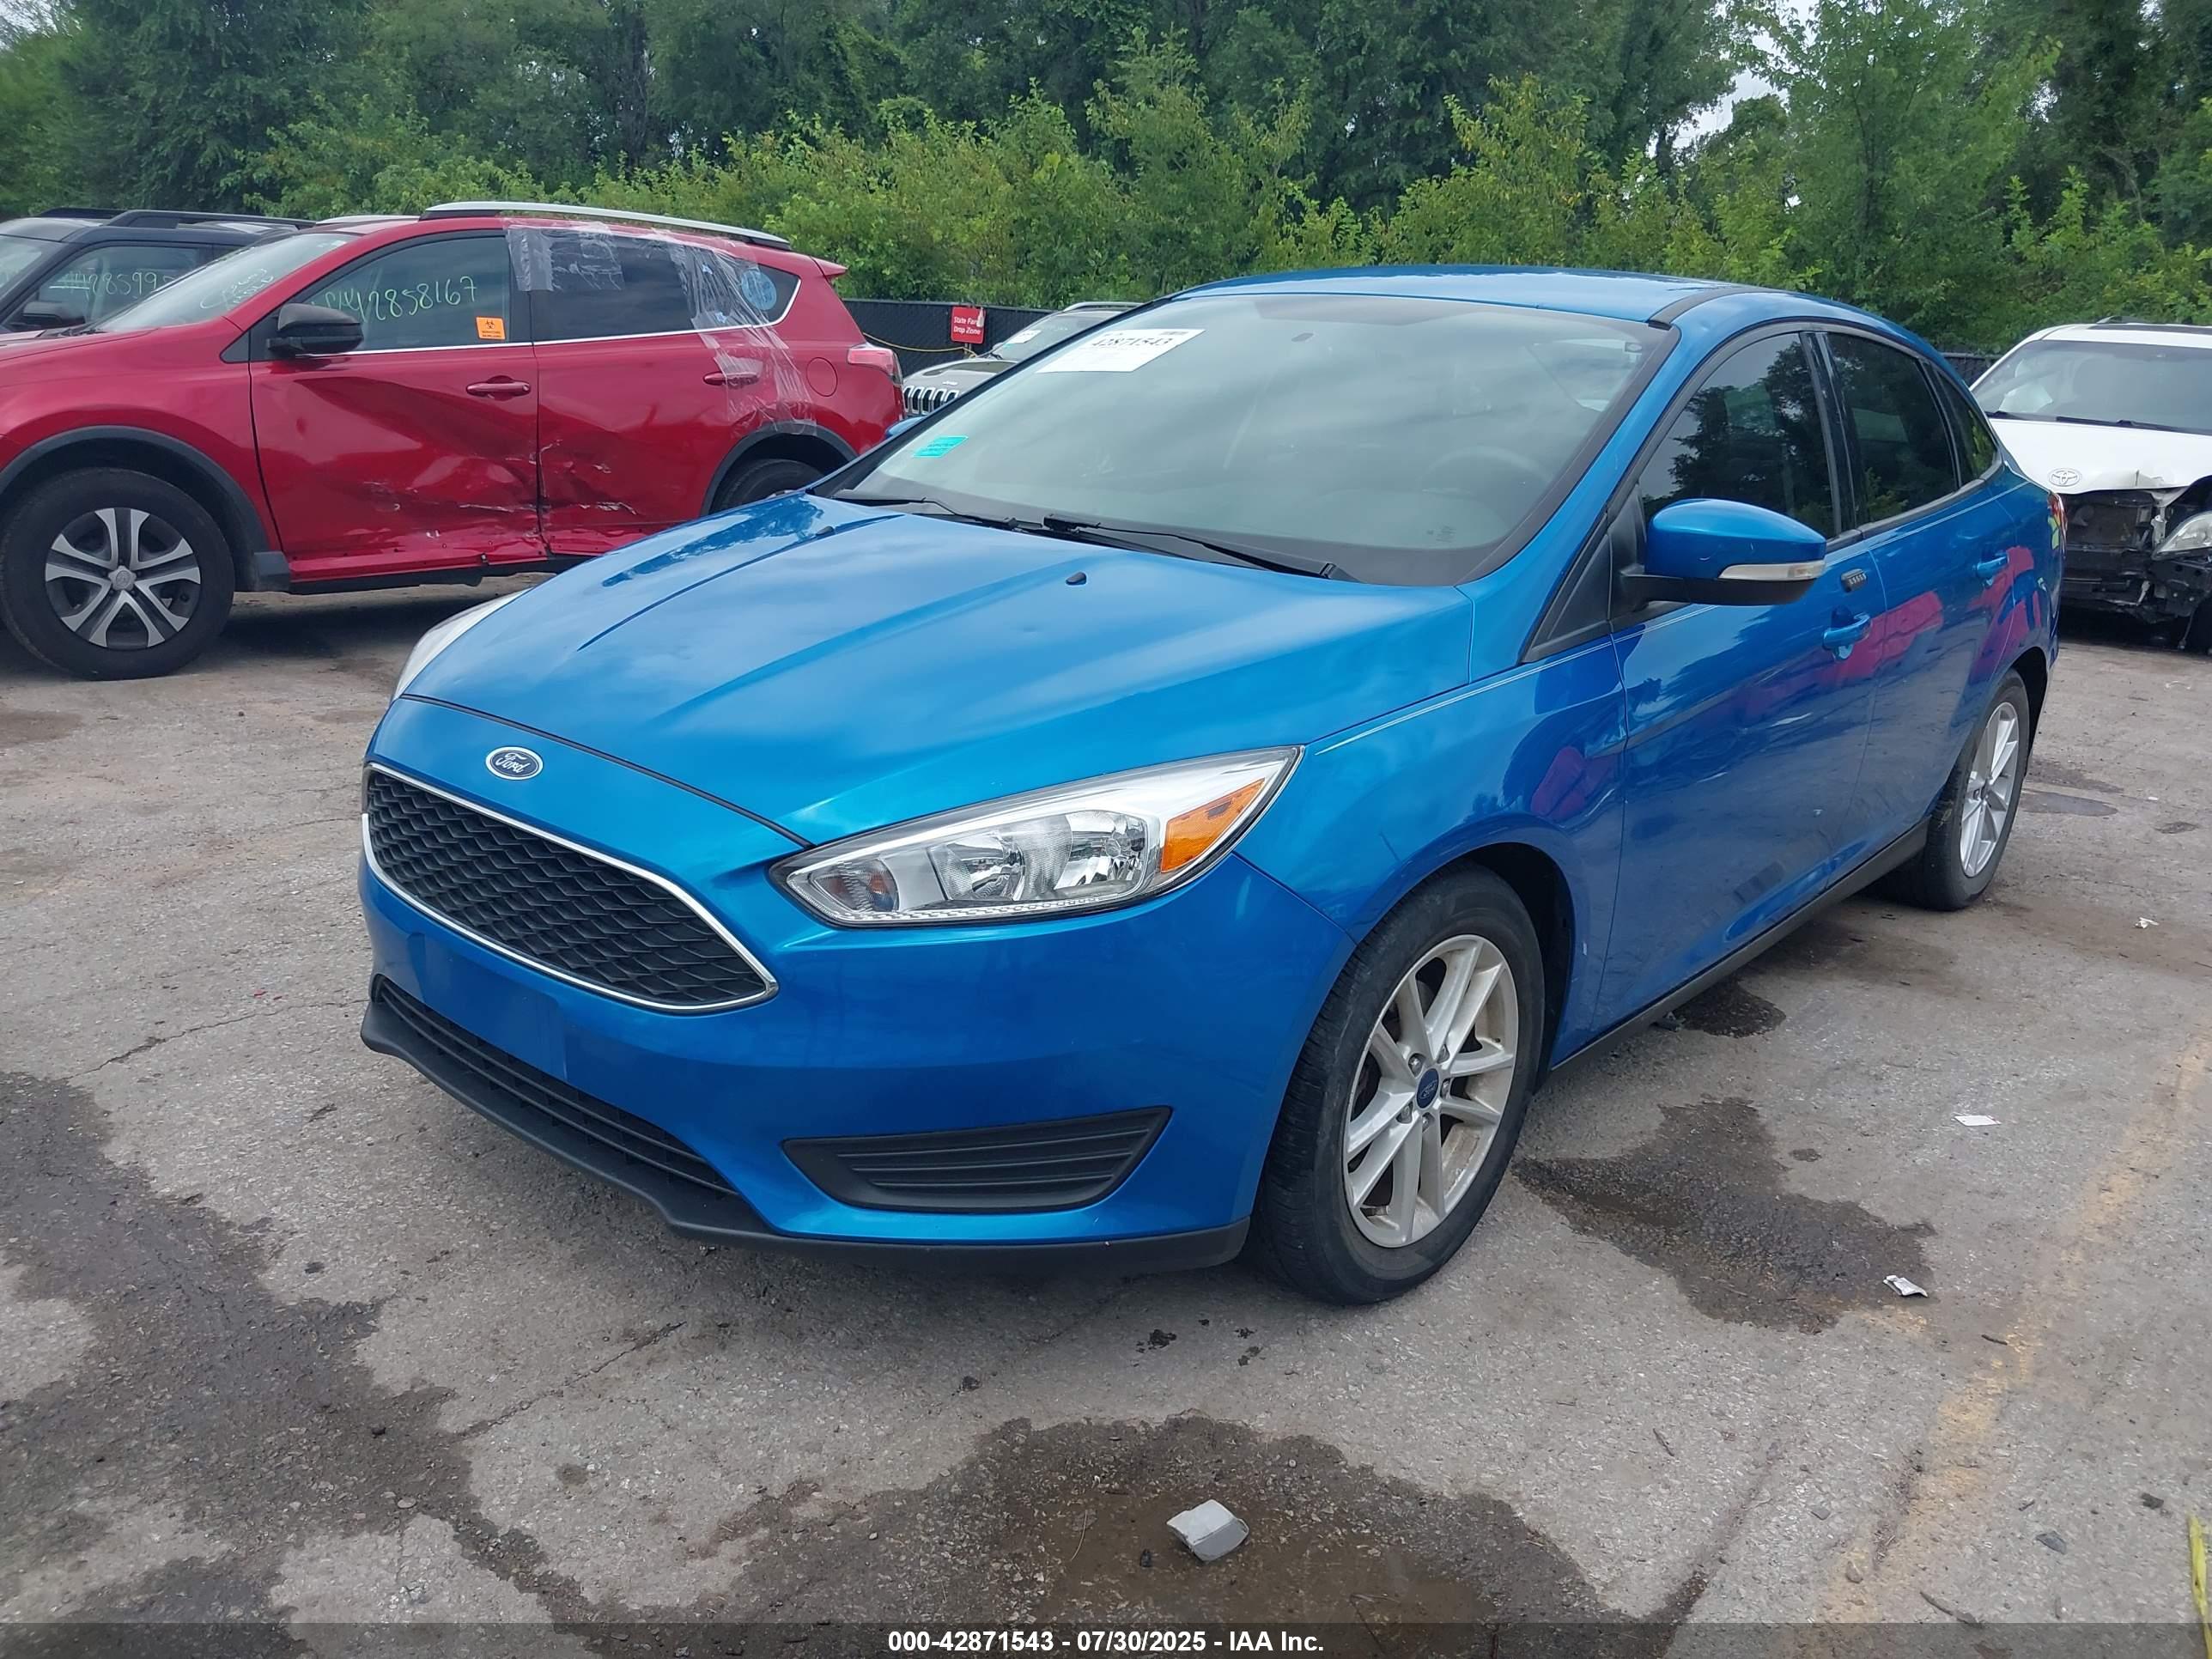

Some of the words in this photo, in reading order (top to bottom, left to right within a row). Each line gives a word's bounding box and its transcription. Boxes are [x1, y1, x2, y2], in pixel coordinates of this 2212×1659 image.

[953, 316, 967, 325] State
[953, 325, 966, 334] Drop
[965, 326, 981, 335] Zone
[495, 752, 532, 774] Ford
